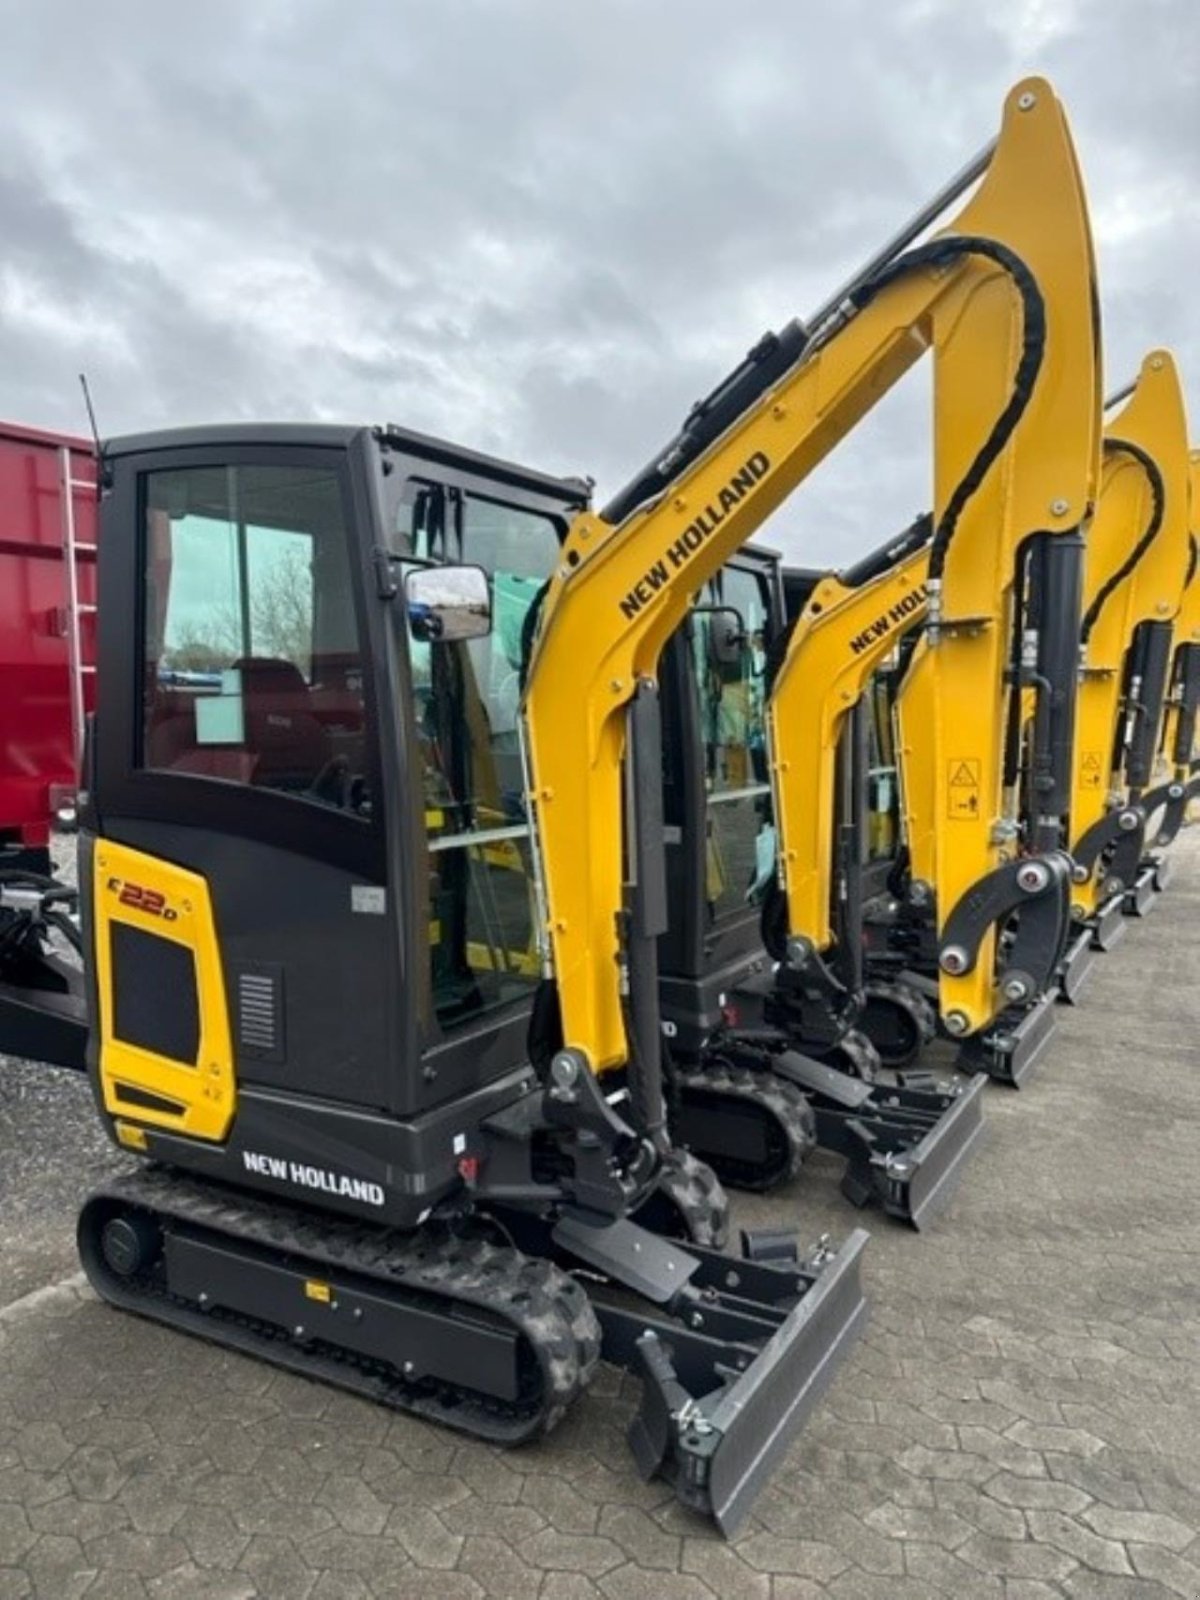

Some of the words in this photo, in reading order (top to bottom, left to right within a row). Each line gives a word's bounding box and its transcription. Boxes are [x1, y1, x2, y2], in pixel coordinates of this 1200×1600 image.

[619, 560, 670, 620] NEW
[666, 451, 770, 569] HOLLAND
[849, 616, 889, 654] NEW
[888, 584, 928, 622] HOLL
[242, 1151, 287, 1180] NEW
[289, 1163, 385, 1206] HOLLAND
